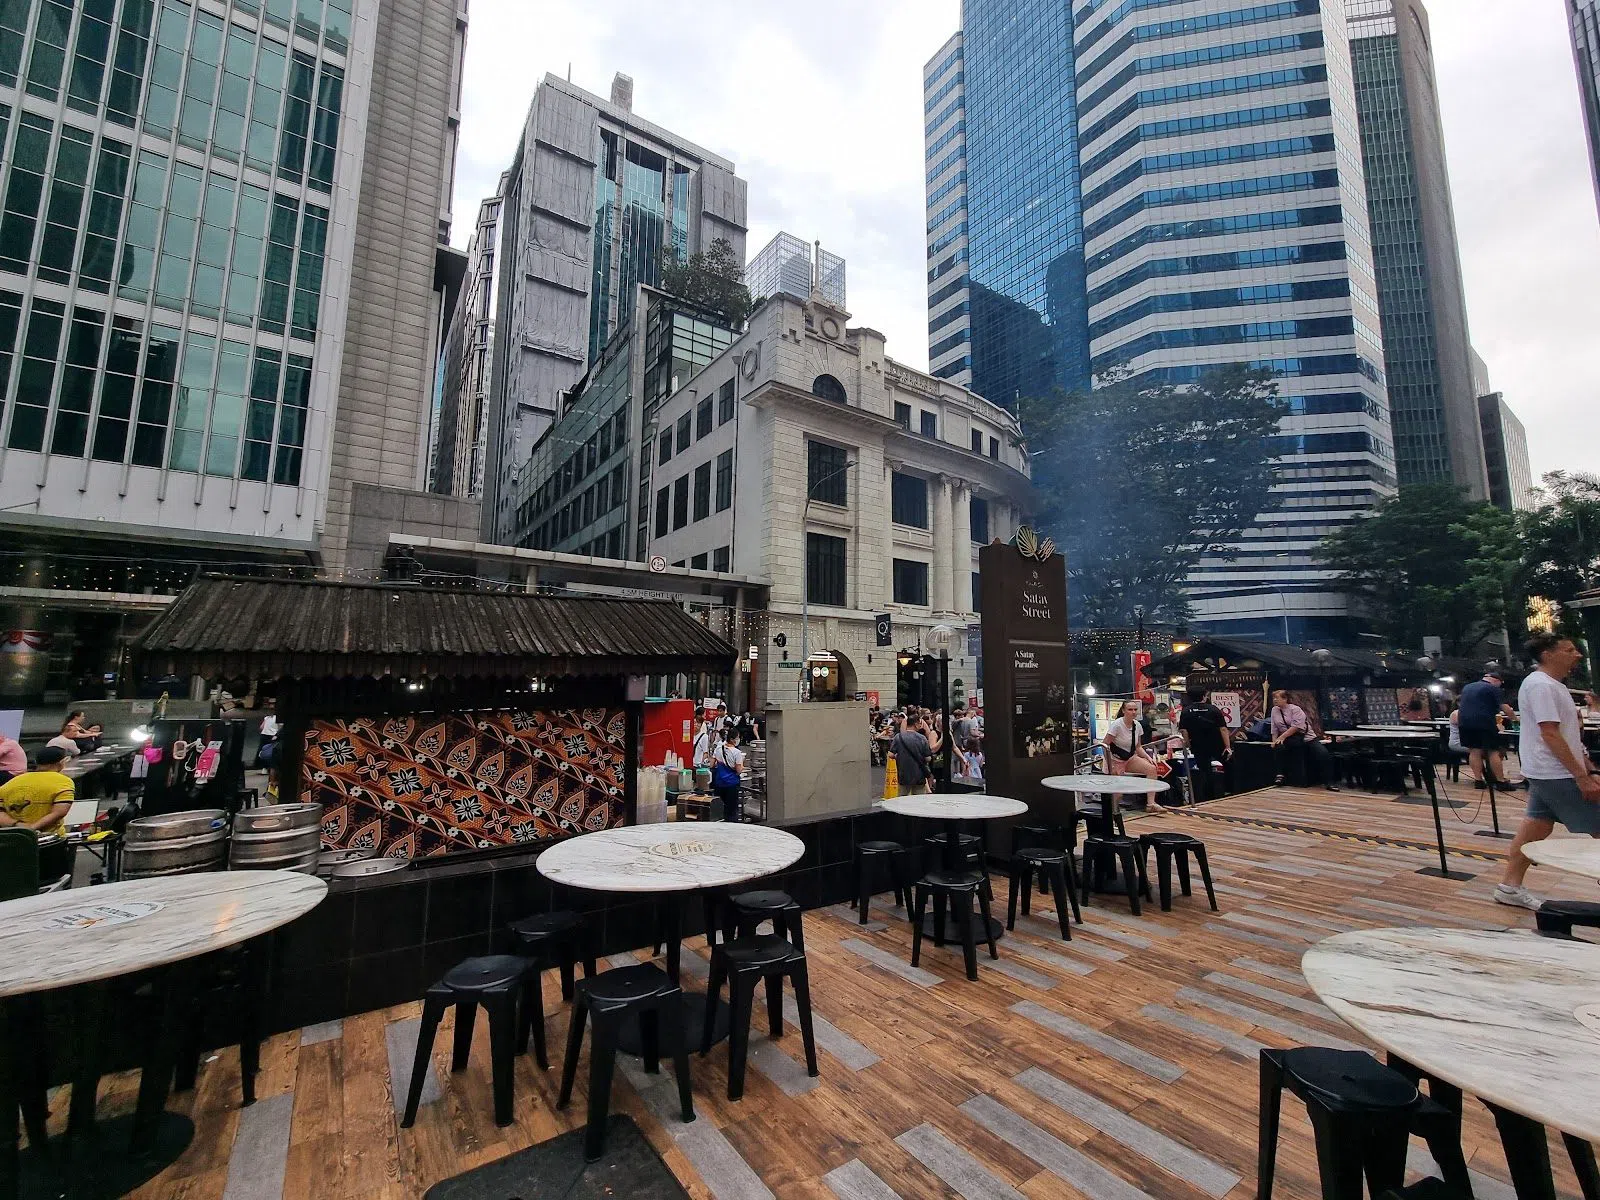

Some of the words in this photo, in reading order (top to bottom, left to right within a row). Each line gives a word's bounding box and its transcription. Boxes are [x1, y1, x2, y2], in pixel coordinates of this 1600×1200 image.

[639, 590, 665, 599] HEIGHT
[1023, 590, 1048, 608] Satay
[1022, 605, 1051, 619] Street
[1020, 650, 1035, 660] Satay
[1014, 659, 1039, 669] Paradise
